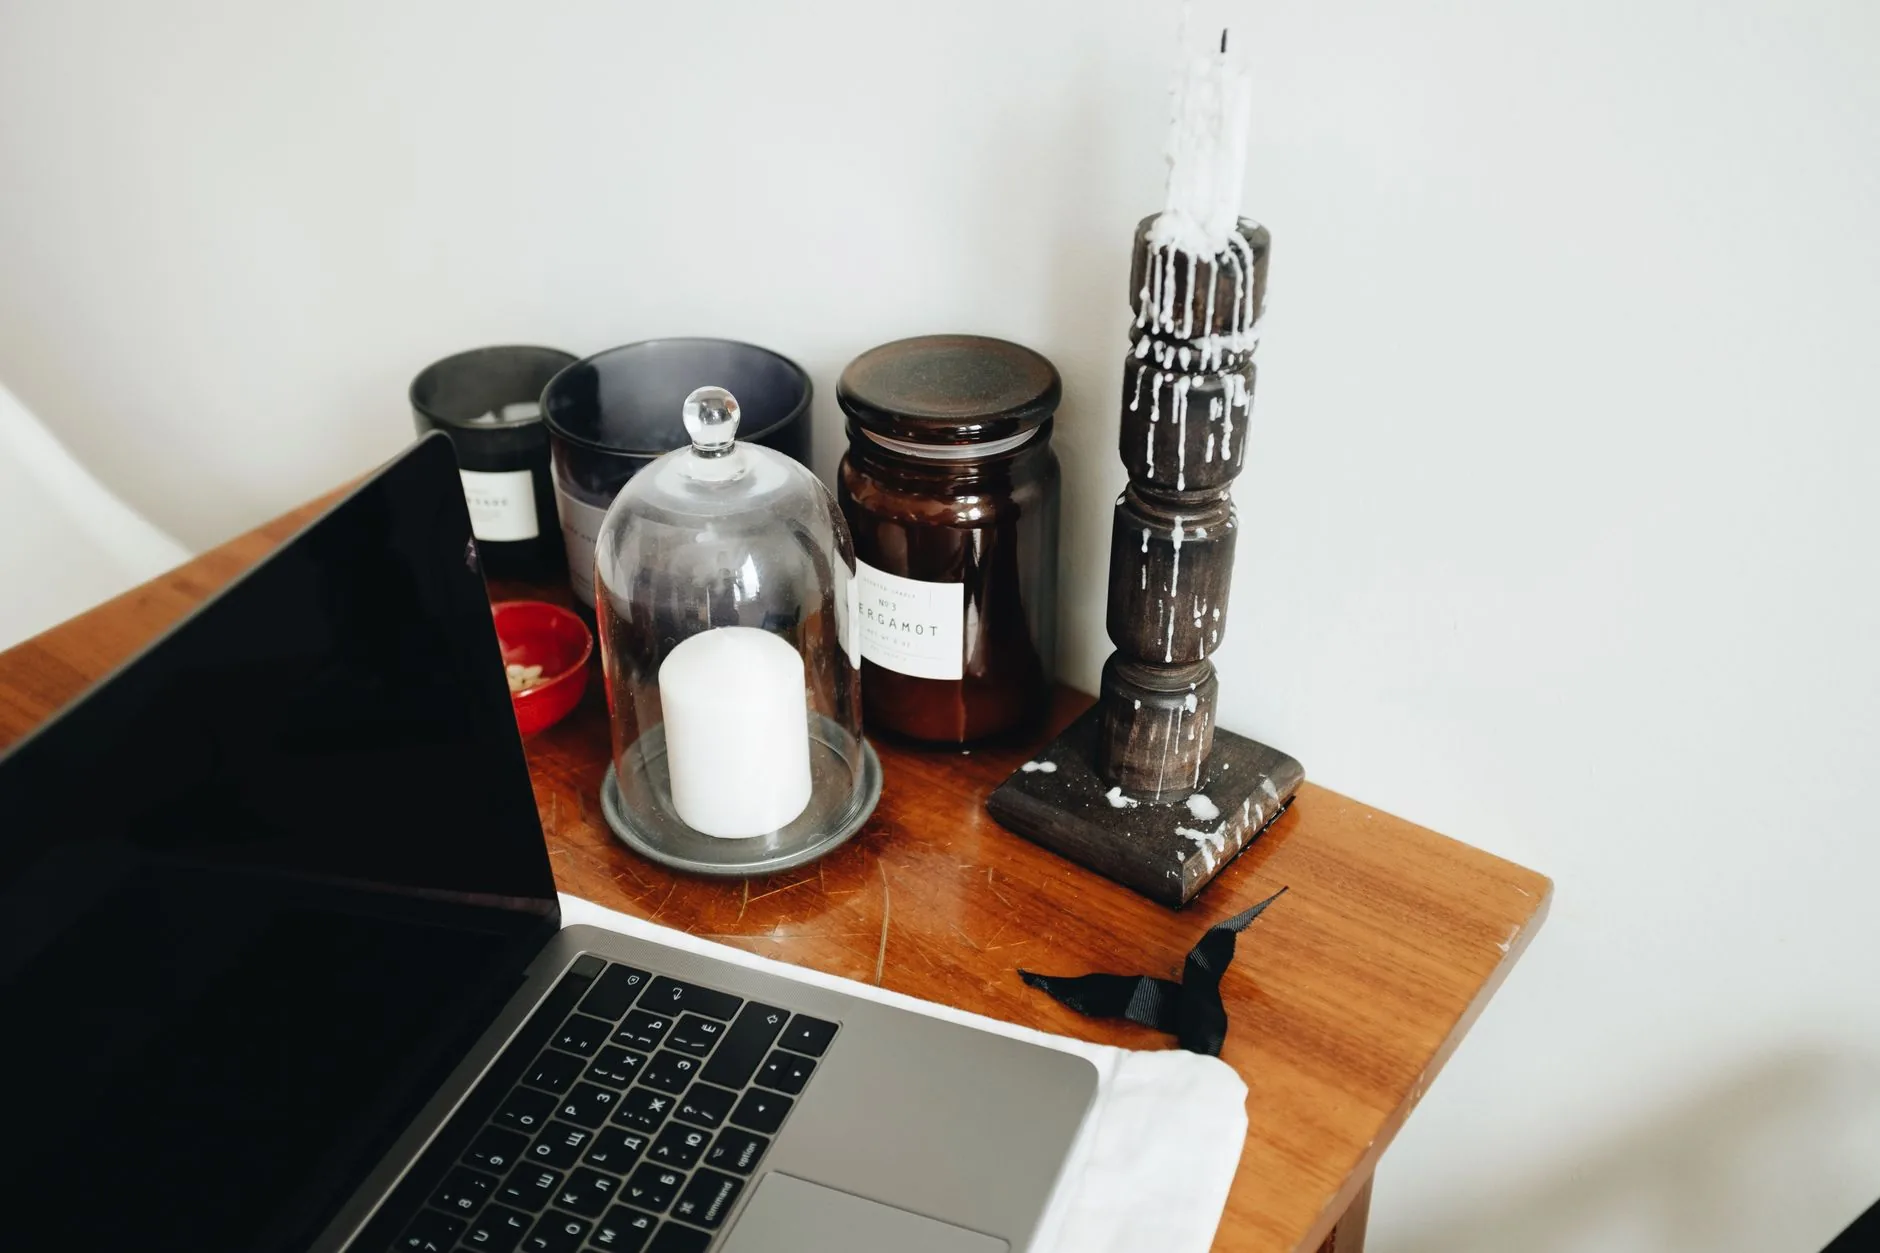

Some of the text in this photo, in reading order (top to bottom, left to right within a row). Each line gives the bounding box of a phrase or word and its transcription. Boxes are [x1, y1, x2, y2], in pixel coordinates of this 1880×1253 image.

[858, 602, 938, 637] ERGAMOT
[738, 1142, 757, 1168] option
[705, 1182, 734, 1221] command
